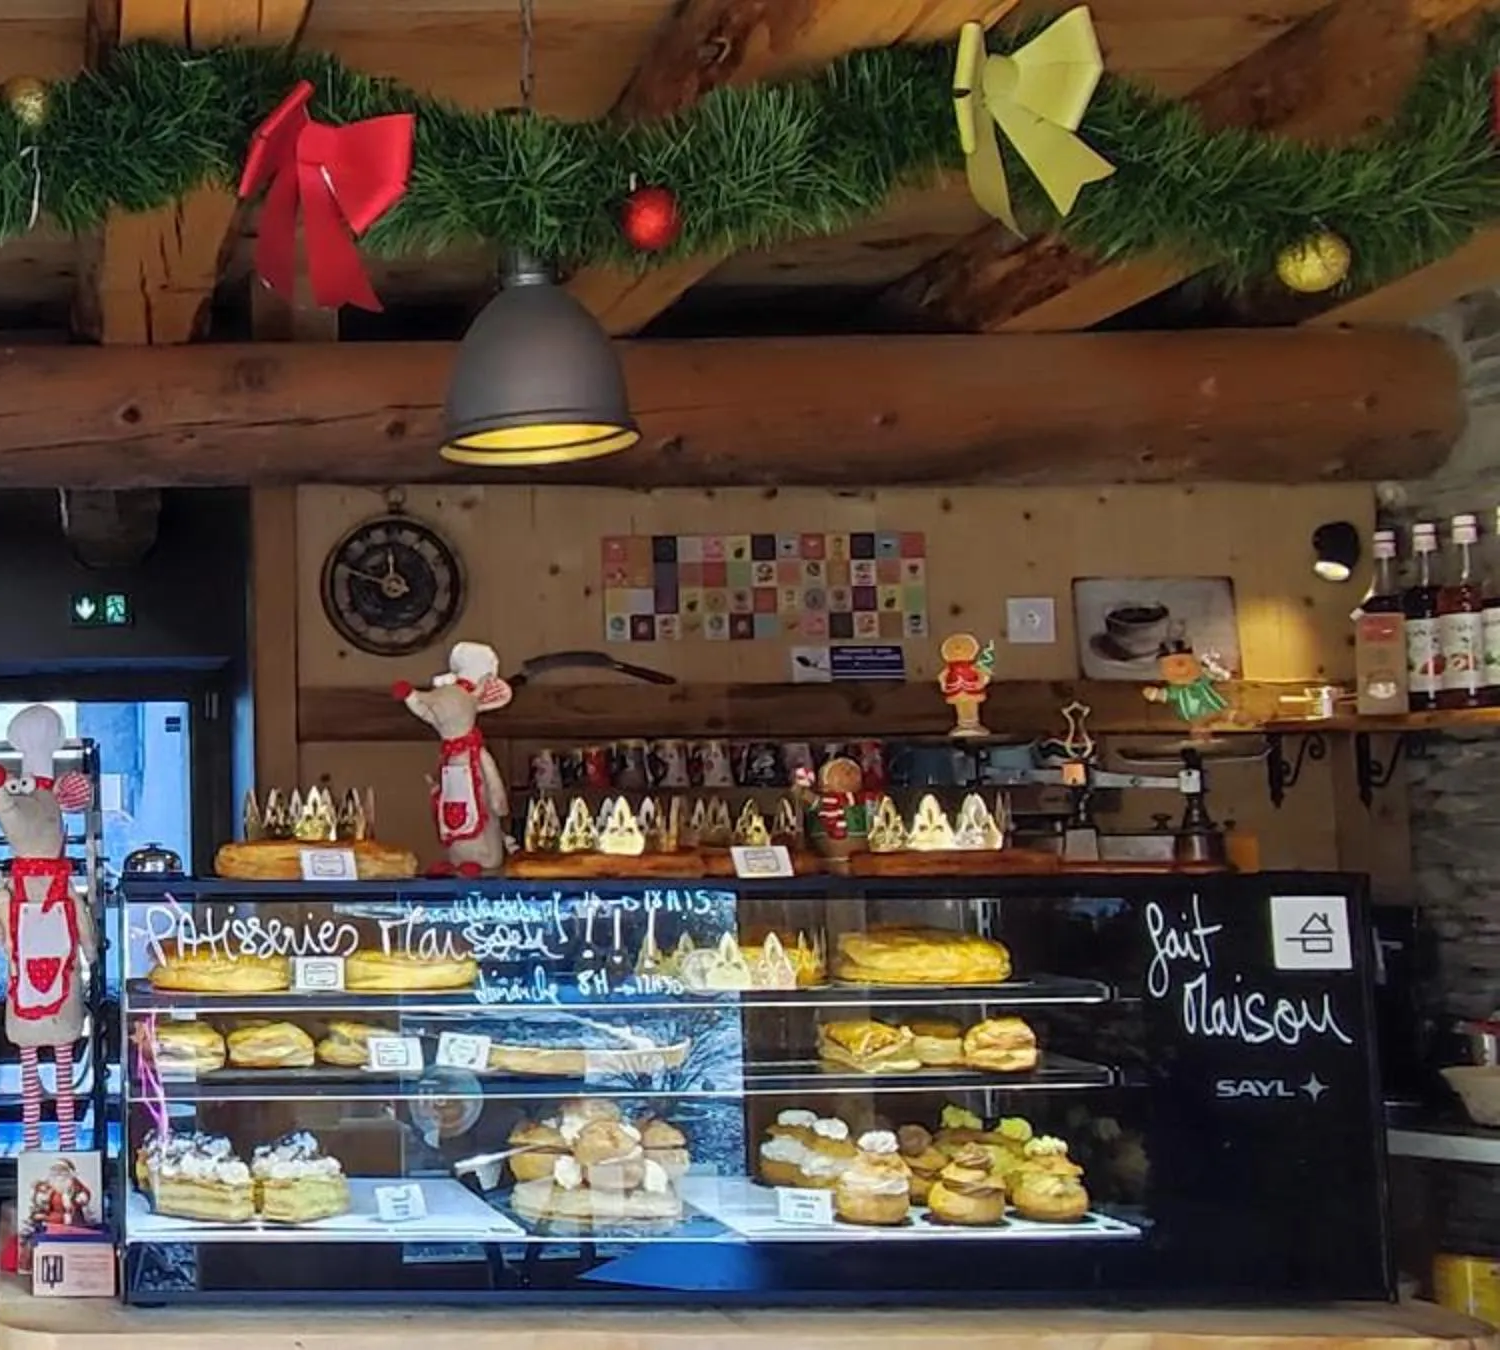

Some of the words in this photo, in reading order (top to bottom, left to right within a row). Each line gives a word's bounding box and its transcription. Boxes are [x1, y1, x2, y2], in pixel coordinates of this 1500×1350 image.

[1145, 893, 1224, 998] fait
[1183, 971, 1353, 1045] Maison
[1215, 1078, 1296, 1098] SAYL
